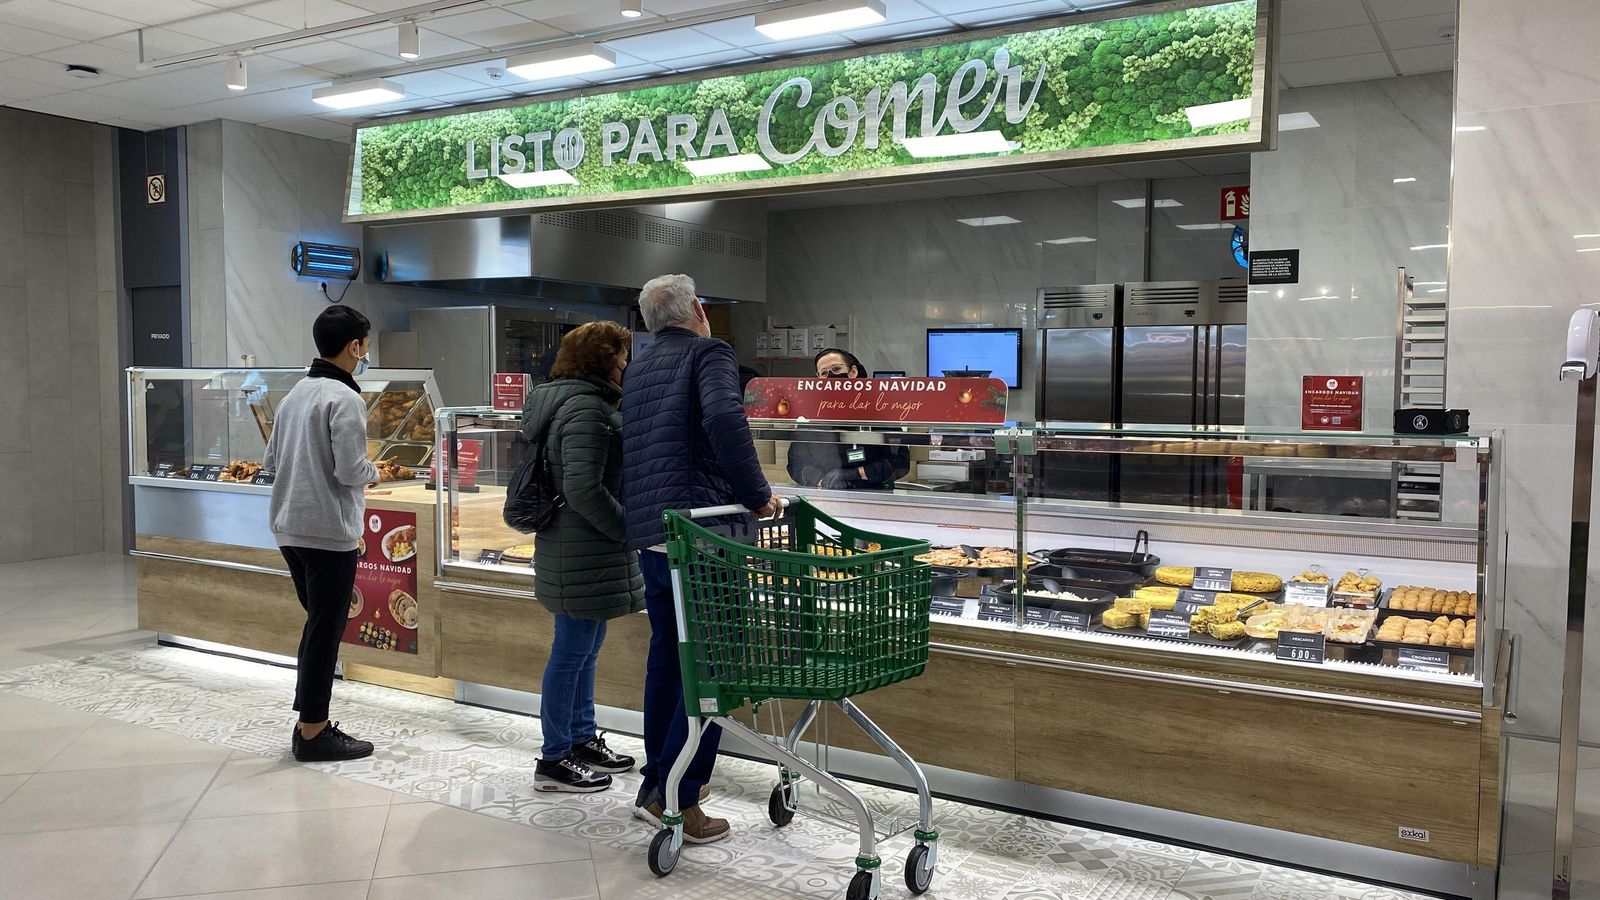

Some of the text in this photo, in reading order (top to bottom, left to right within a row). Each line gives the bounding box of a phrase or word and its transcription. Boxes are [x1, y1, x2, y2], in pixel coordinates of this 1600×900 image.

[465, 47, 1047, 179] LISTO PARA Comer
[797, 380, 947, 392] ENCARGOS NAVIDAD
[817, 392, 923, 420] para dar lo mejor
[380, 565, 412, 574] NAVIDAD
[1411, 654, 1442, 662] CROQUETAS
[1401, 829, 1427, 839] exkal
